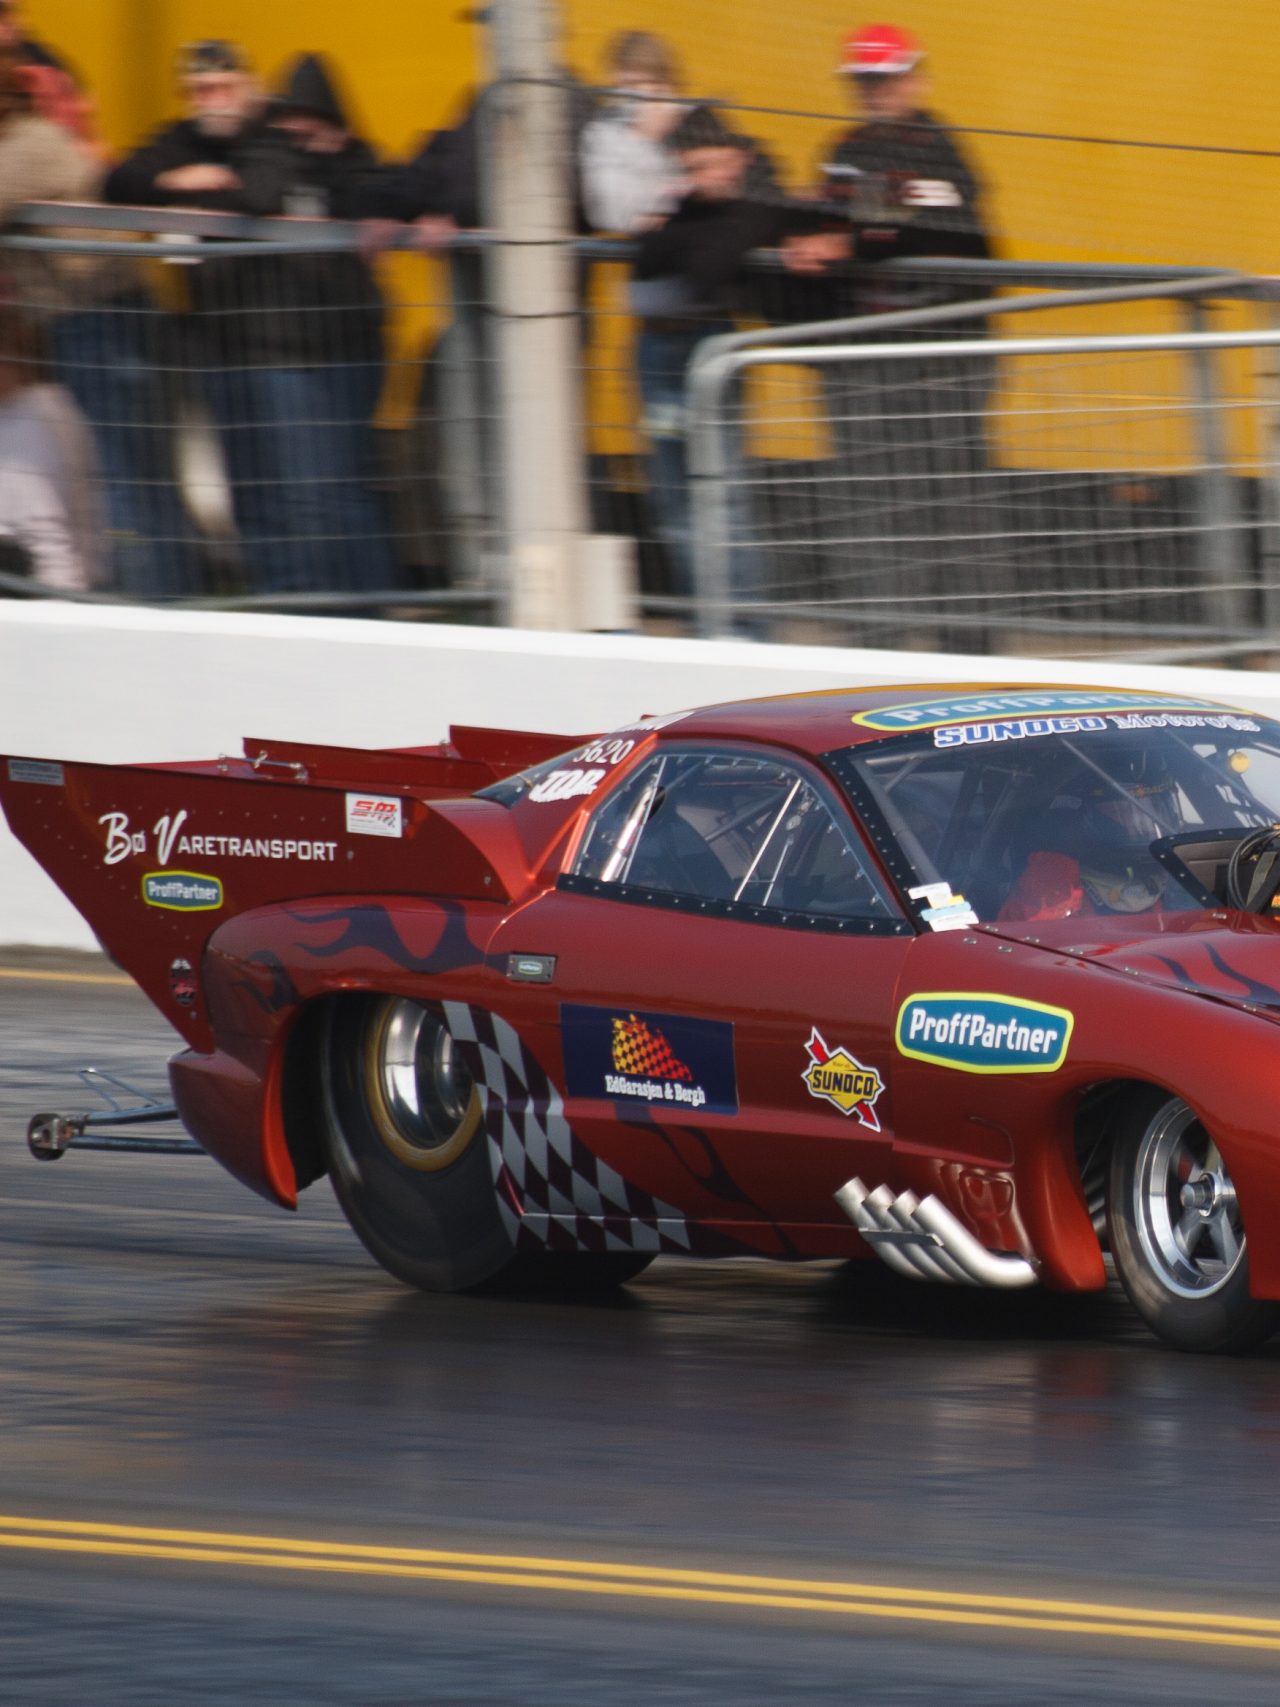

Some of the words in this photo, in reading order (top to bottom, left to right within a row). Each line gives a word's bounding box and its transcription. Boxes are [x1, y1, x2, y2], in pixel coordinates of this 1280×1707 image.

[933, 716, 1106, 748] SUNOCO
[152, 809, 338, 866] VARETRANSPORT
[146, 880, 218, 902] ProffPartner
[908, 1007, 1058, 1054] ProffPartner
[664, 1082, 674, 1100] &
[673, 1082, 706, 1107] Bergh
[812, 1069, 874, 1097] SUNOCO
